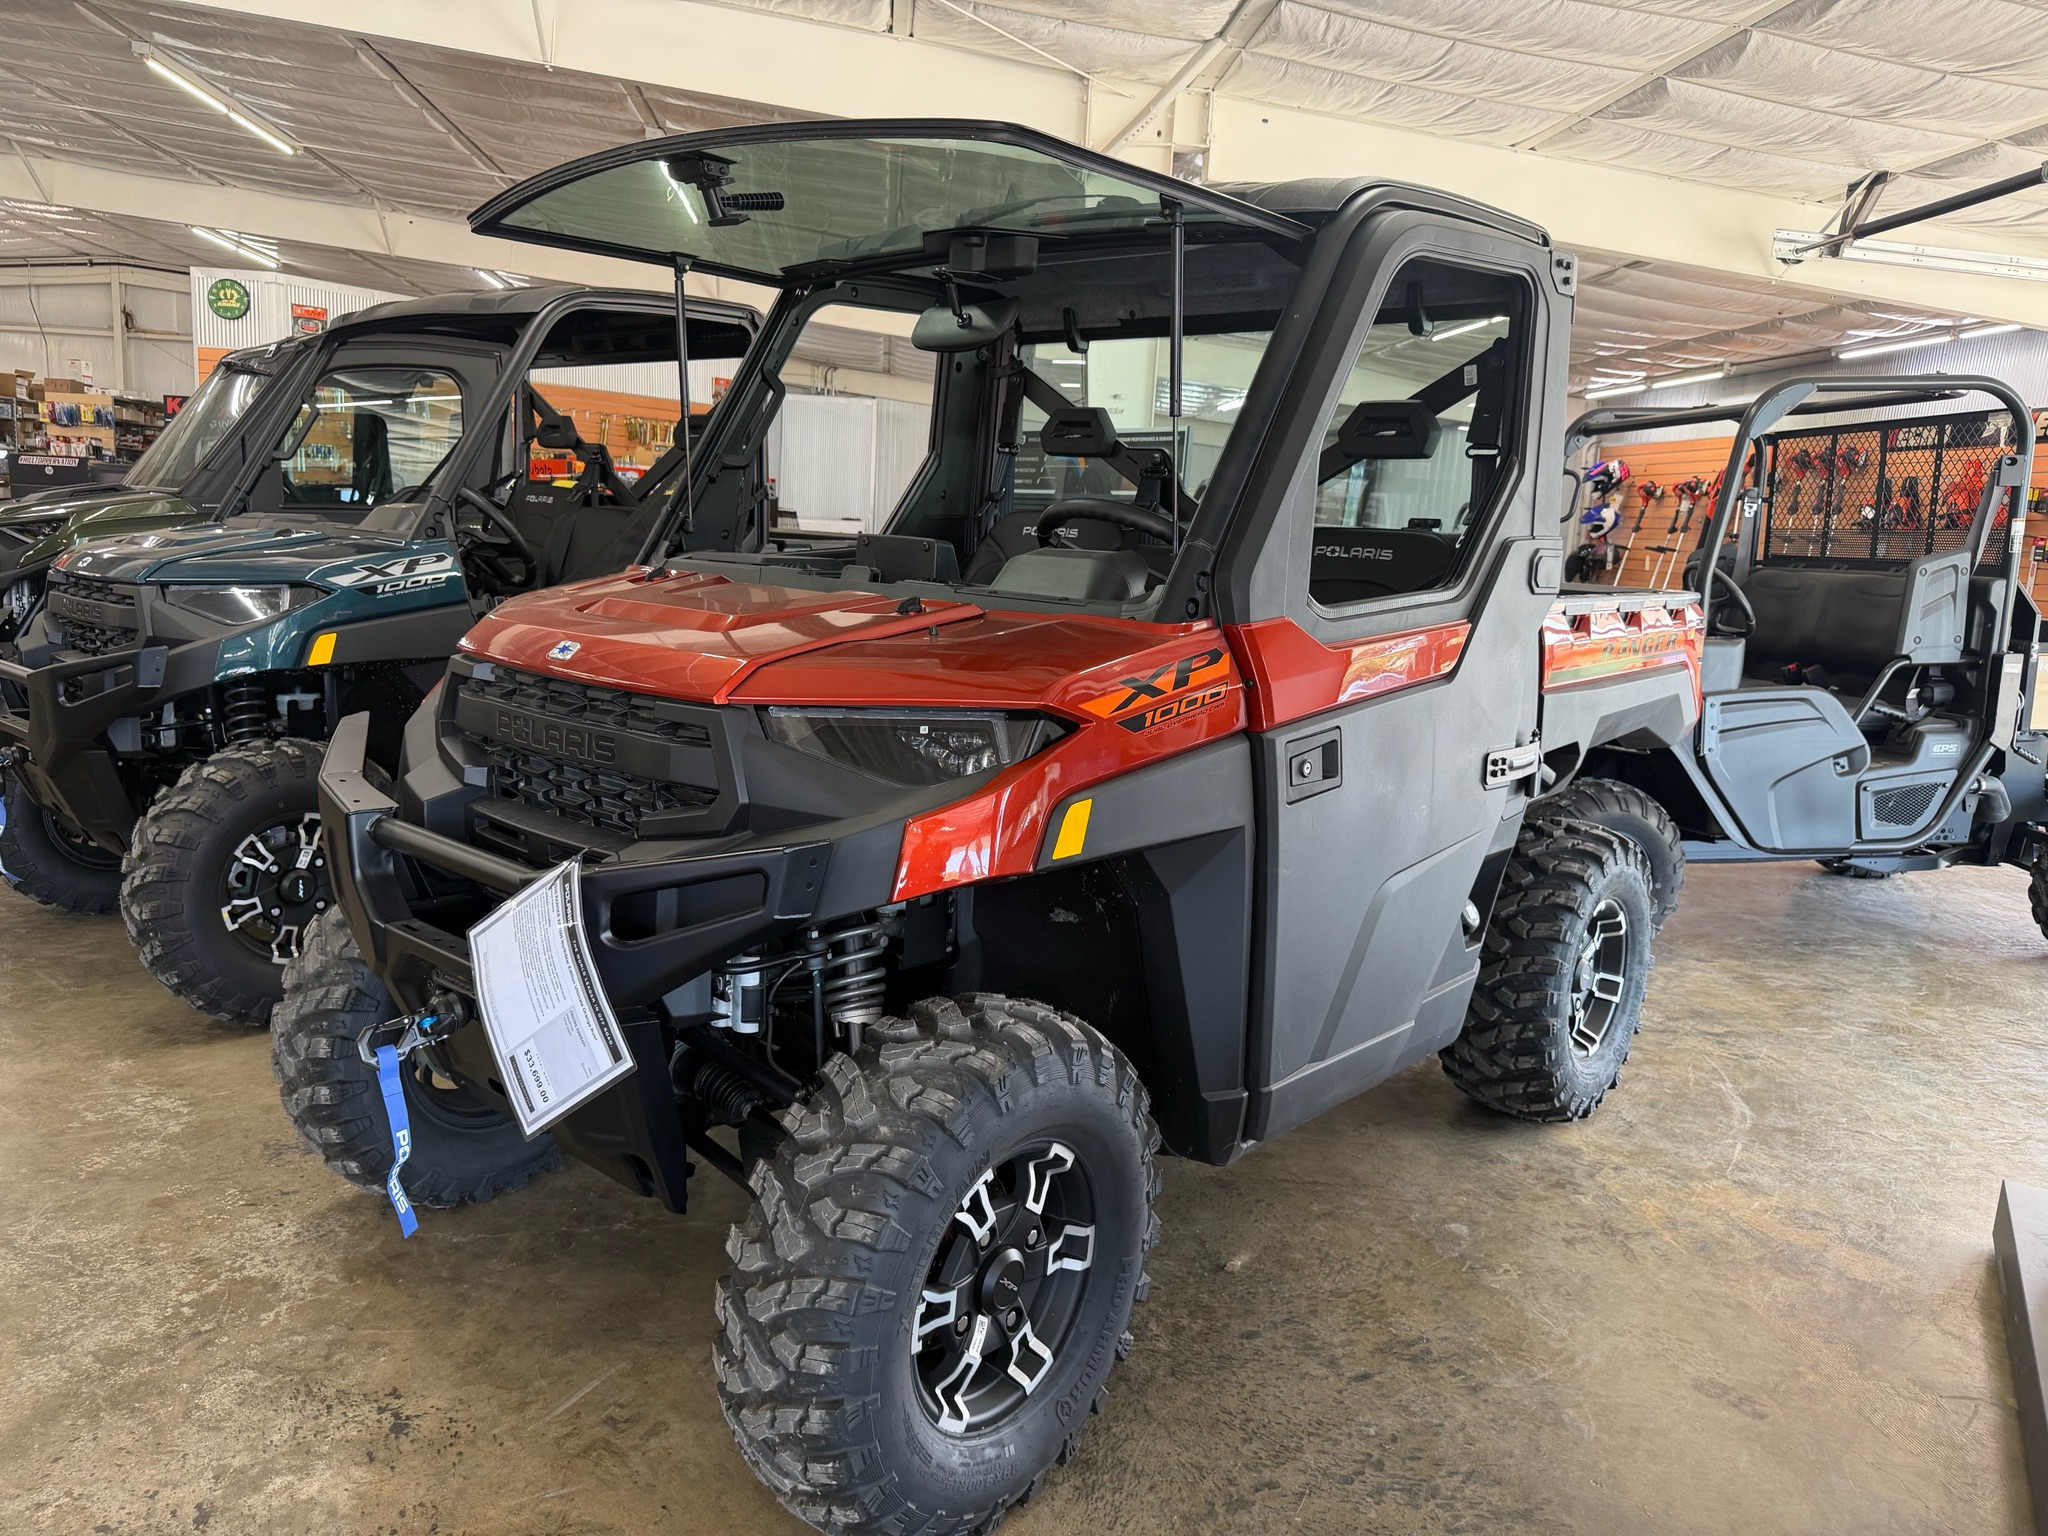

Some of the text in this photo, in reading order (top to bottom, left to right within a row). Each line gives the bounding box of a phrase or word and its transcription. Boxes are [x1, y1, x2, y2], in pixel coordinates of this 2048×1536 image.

[19, 456, 78, 467] #HILLTOPPERNATION
[530, 464, 553, 475] ubota
[526, 495, 554, 504] POLARIS
[1022, 526, 1079, 538] PORIS
[349, 552, 451, 585] XP
[1313, 545, 1394, 561] POLARIS
[376, 574, 448, 594] 1000
[396, 585, 431, 596] OVERHEAD
[61, 598, 104, 621] POLARIS
[1600, 632, 1679, 662] RANGER
[1107, 647, 1226, 715] XP
[1143, 683, 1228, 728] 1000
[1143, 702, 1226, 738] DUAL OVERHEAD CAM
[496, 709, 617, 765] POLARIS
[1932, 744, 1958, 753] EPS
[564, 882, 573, 928] POLARIS
[561, 939, 569, 963] NorthStar
[567, 963, 575, 985] Edition
[573, 984, 584, 1006] Ultimate
[582, 1007, 592, 1028] Orange
[590, 1027, 598, 1041] Rust
[576, 953, 587, 976] WORLD
[584, 976, 596, 1003] LEADER
[594, 1002, 600, 1012] IN
[597, 1013, 606, 1025] OFF
[524, 1048, 550, 1103] $33,699.00
[896, 1150, 990, 1338] X-TERRAIN
[999, 1276, 1019, 1292] XP
[1070, 1311, 1119, 1401] ARMOR
